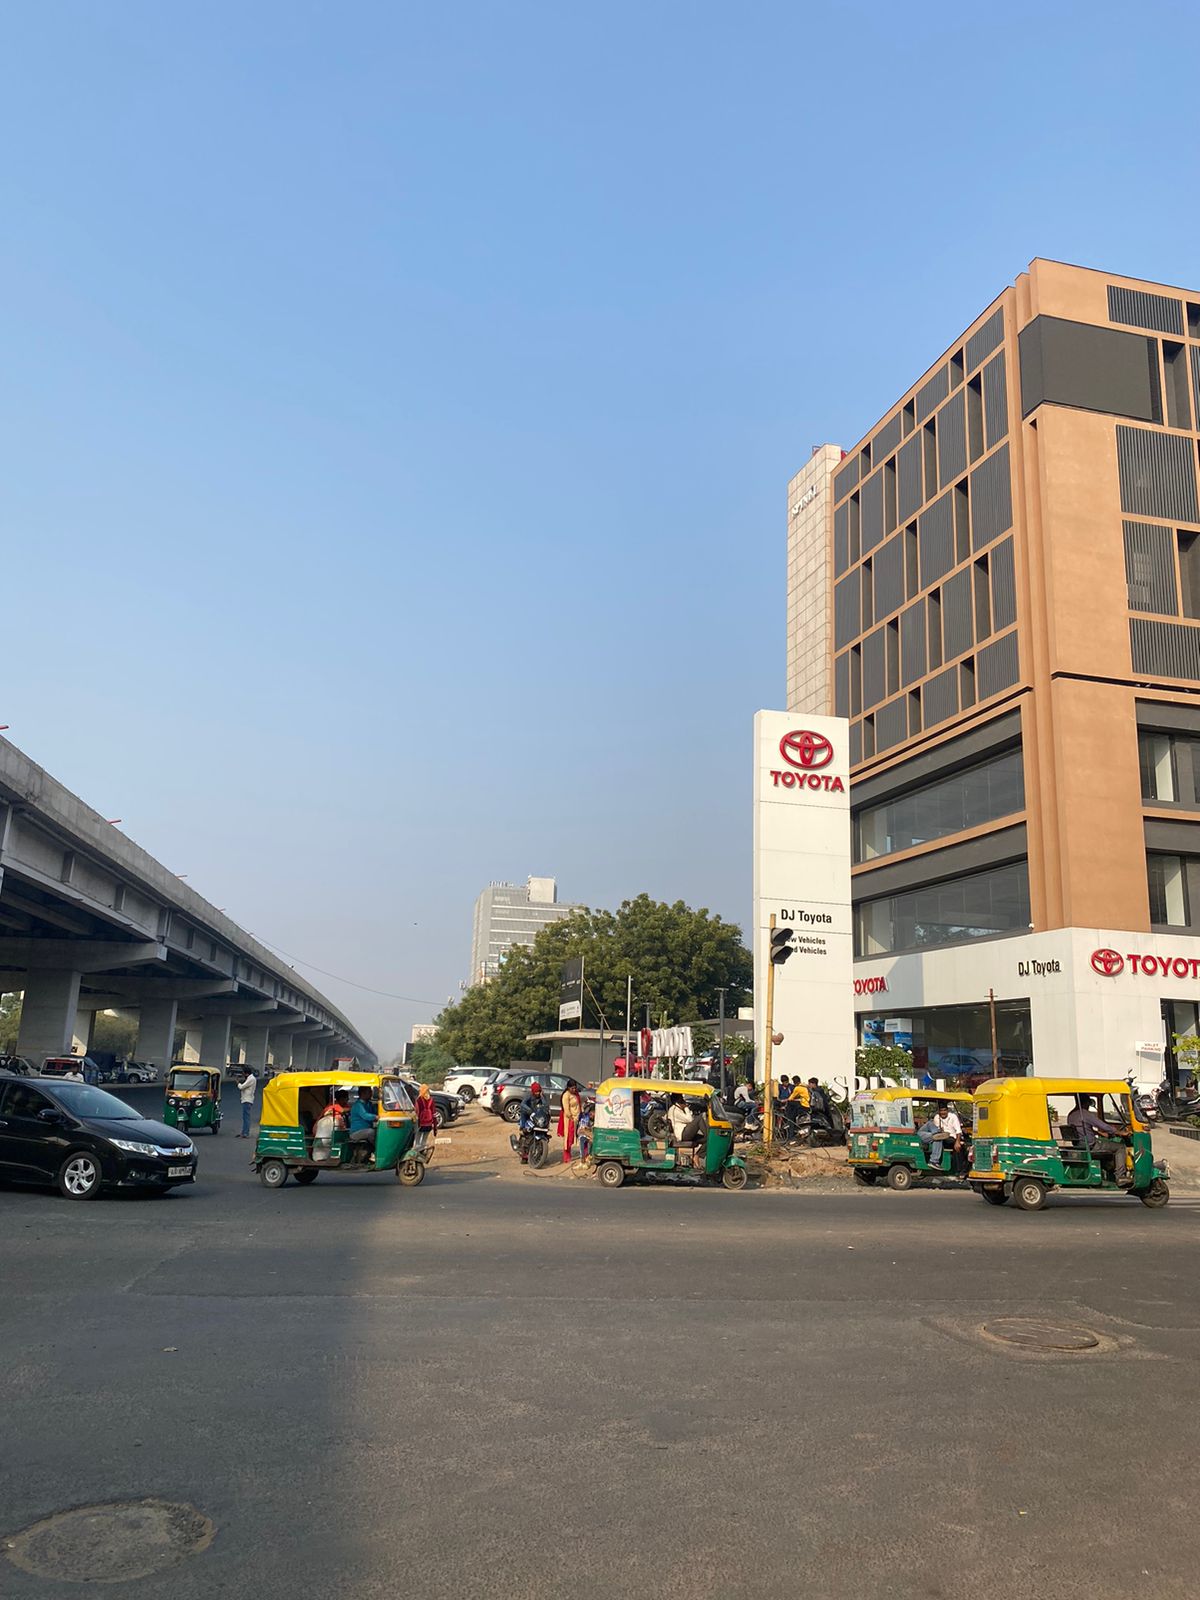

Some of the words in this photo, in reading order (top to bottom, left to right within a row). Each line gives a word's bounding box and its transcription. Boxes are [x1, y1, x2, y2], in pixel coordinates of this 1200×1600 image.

[770, 770, 844, 793] TOYOTA
[781, 909, 795, 920] DJ
[798, 910, 832, 925] Toyota
[798, 936, 826, 945] Vehicles
[799, 946, 827, 955] Vehicles
[1018, 961, 1030, 976] DJ
[1031, 959, 1061, 977] Toyota
[1126, 954, 1200, 979] TOYOT
[853, 976, 889, 994] OYOTA
